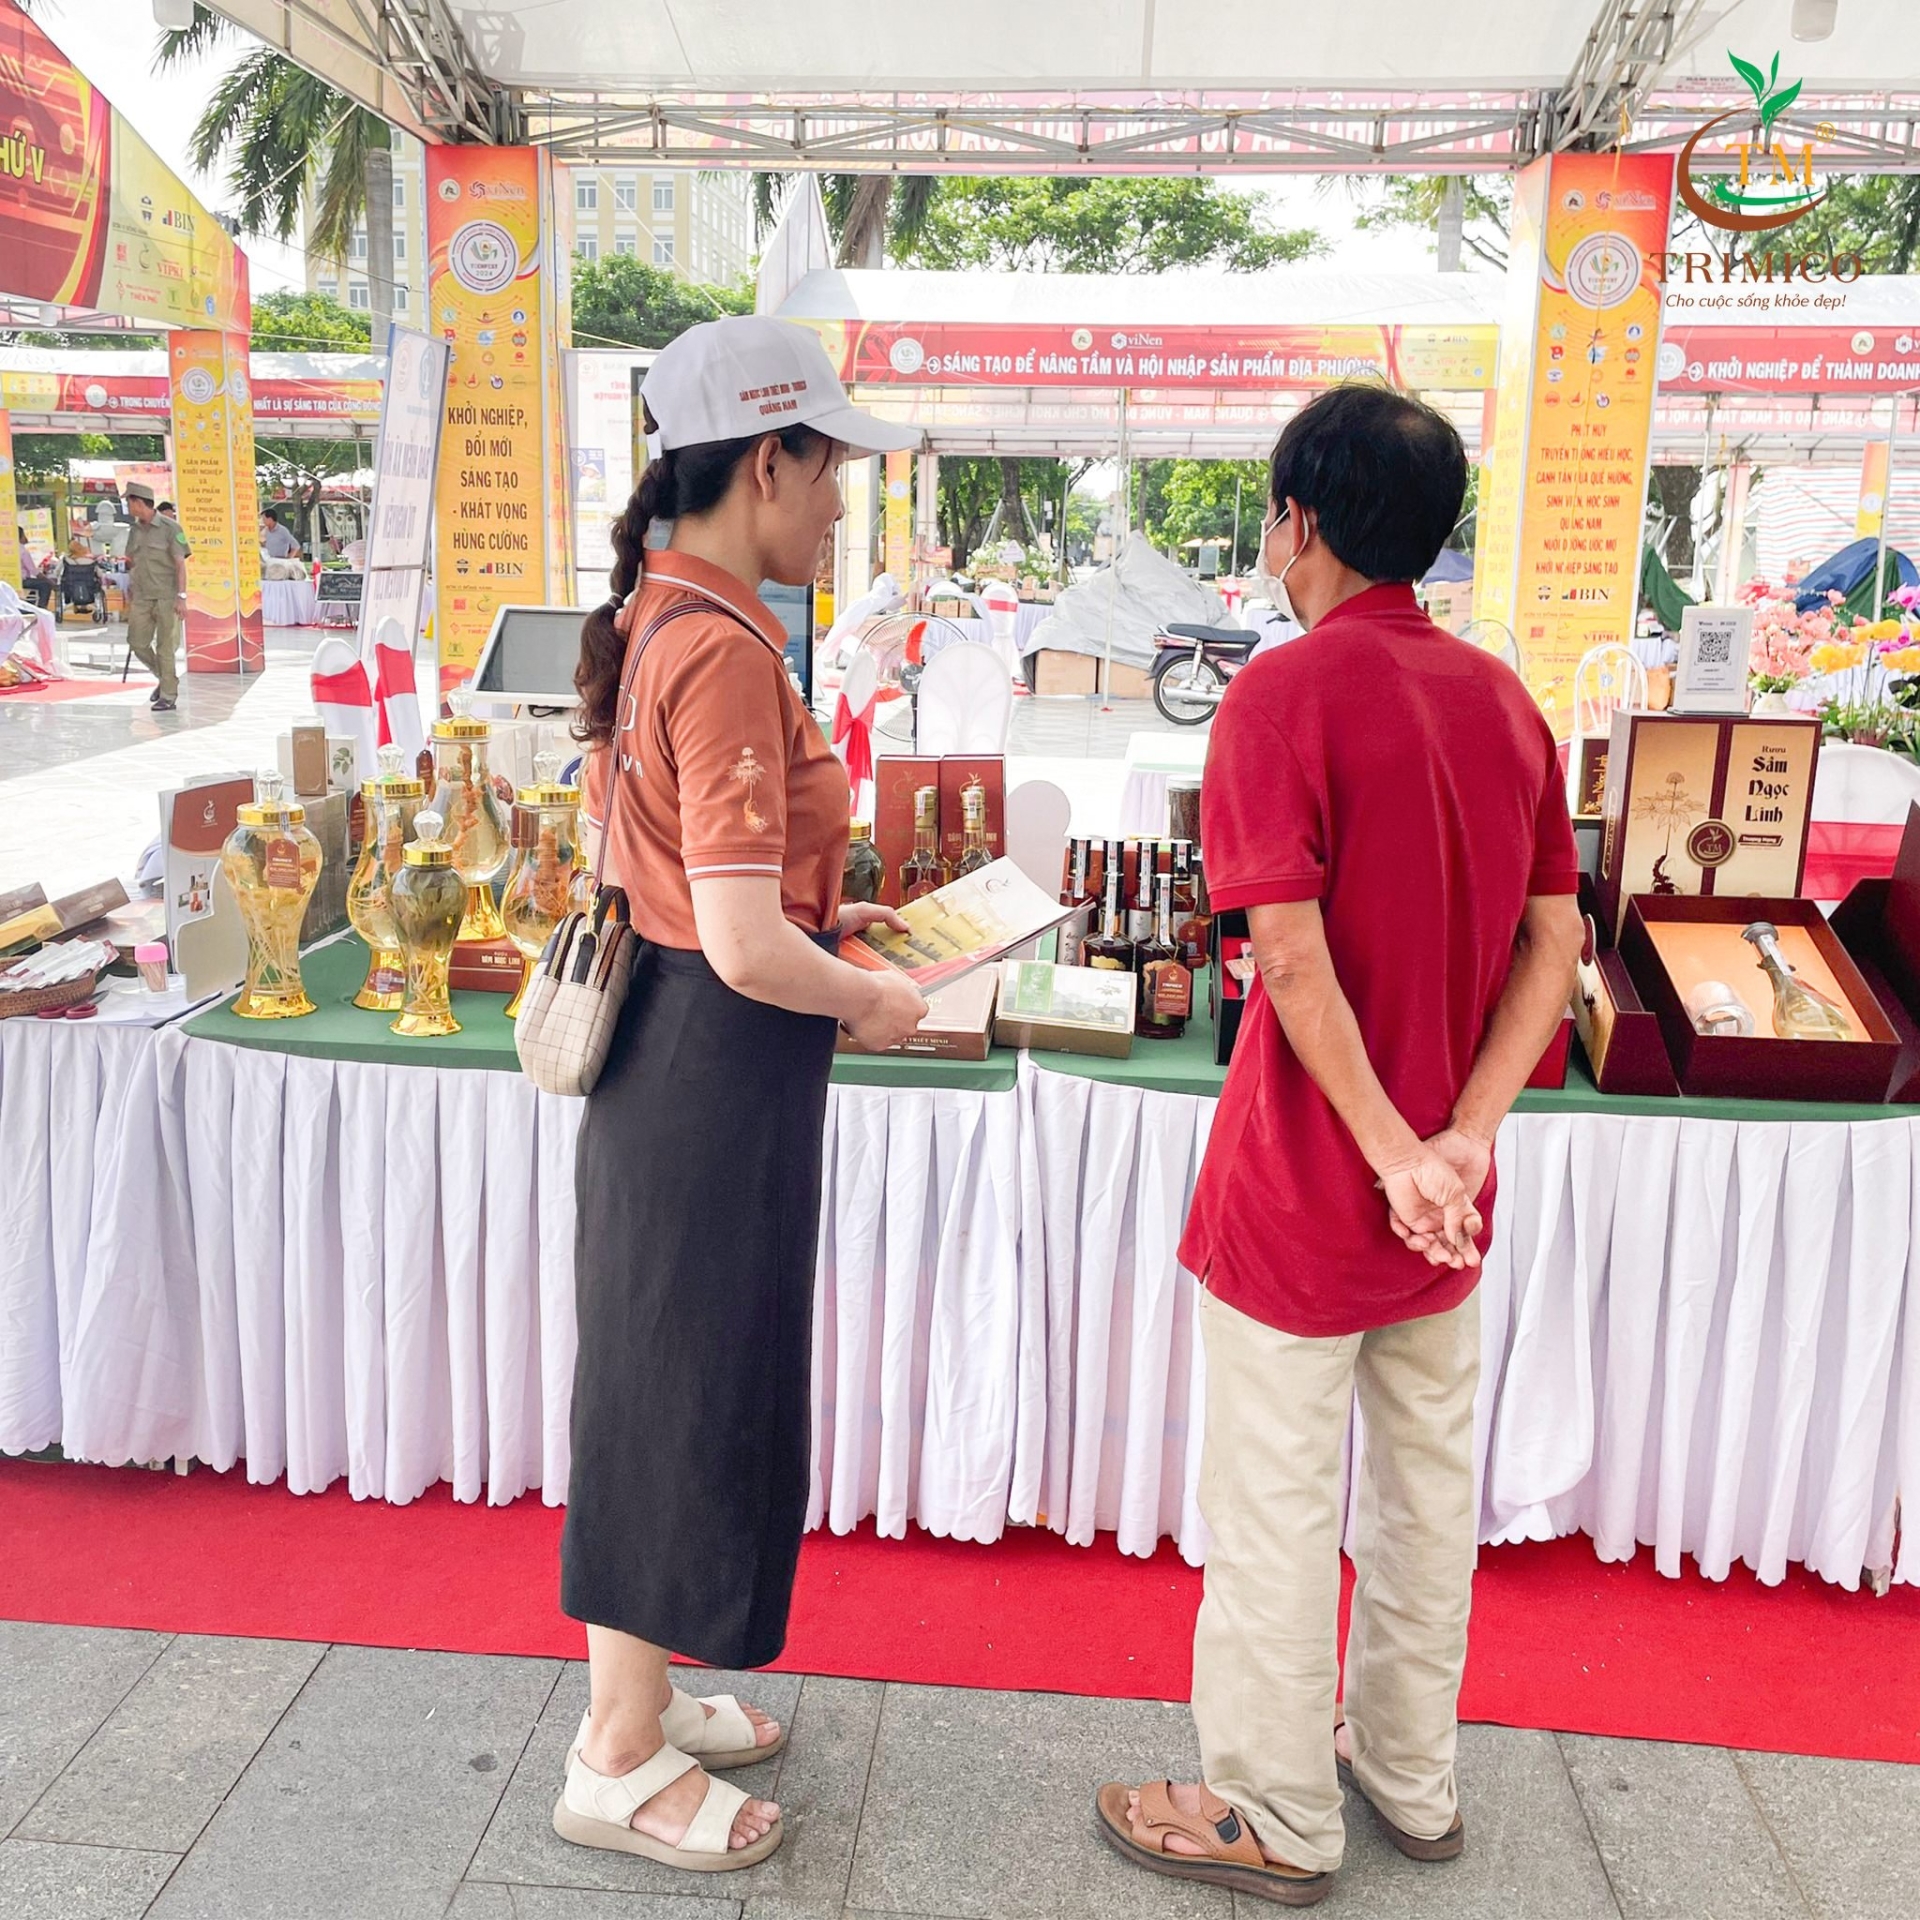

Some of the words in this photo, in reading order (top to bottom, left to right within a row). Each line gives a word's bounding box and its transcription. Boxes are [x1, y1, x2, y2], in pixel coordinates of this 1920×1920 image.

[29, 144, 46, 185] V
[1128, 333, 1163, 347] viNen
[943, 351, 980, 373] SÁNG
[983, 355, 1012, 376] TẠO
[1015, 347, 1037, 373] ĐỂ
[1039, 352, 1077, 374] NÂNG
[1081, 350, 1112, 375] TẦM
[1115, 352, 1135, 376] VÀ
[1138, 354, 1163, 379] HỘI
[1167, 354, 1206, 380] NHẬP
[1209, 351, 1236, 377] SẢN
[1241, 350, 1286, 377] PHẨM
[1288, 357, 1314, 379] ĐỊA
[1317, 357, 1377, 377] PHƯƠNG
[1708, 355, 1742, 380] KHỞI
[1746, 358, 1799, 383] NGHIỆP
[1801, 354, 1824, 380] ĐỂ
[1826, 357, 1874, 380] THÀNH
[253, 396, 272, 411] NHẤT
[272, 397, 282, 411] LÀ
[293, 397, 313, 411] SÁNG
[448, 400, 477, 425] KHỞI
[481, 403, 528, 430] NGHIỆP,
[1571, 423, 1590, 437] PHT
[1592, 424, 1607, 437] HUY
[465, 430, 486, 457] ĐỔI
[490, 435, 512, 457] MỚI
[460, 466, 491, 488] SÁNG
[495, 470, 518, 492] TẠO
[460, 497, 492, 519] KHÁT
[496, 502, 527, 523] VỌNG
[1546, 495, 1563, 508] SINH
[1603, 495, 1620, 509] SINH
[1586, 517, 1602, 530] NAM
[453, 528, 485, 550] HÙNG
[489, 528, 528, 551] CƯỜNG
[495, 562, 524, 574] BIN
[1580, 588, 1610, 600] BIN
[1751, 756, 1788, 774] Sâm
[1748, 779, 1790, 800] Ngọc
[1744, 805, 1783, 824] Linh
